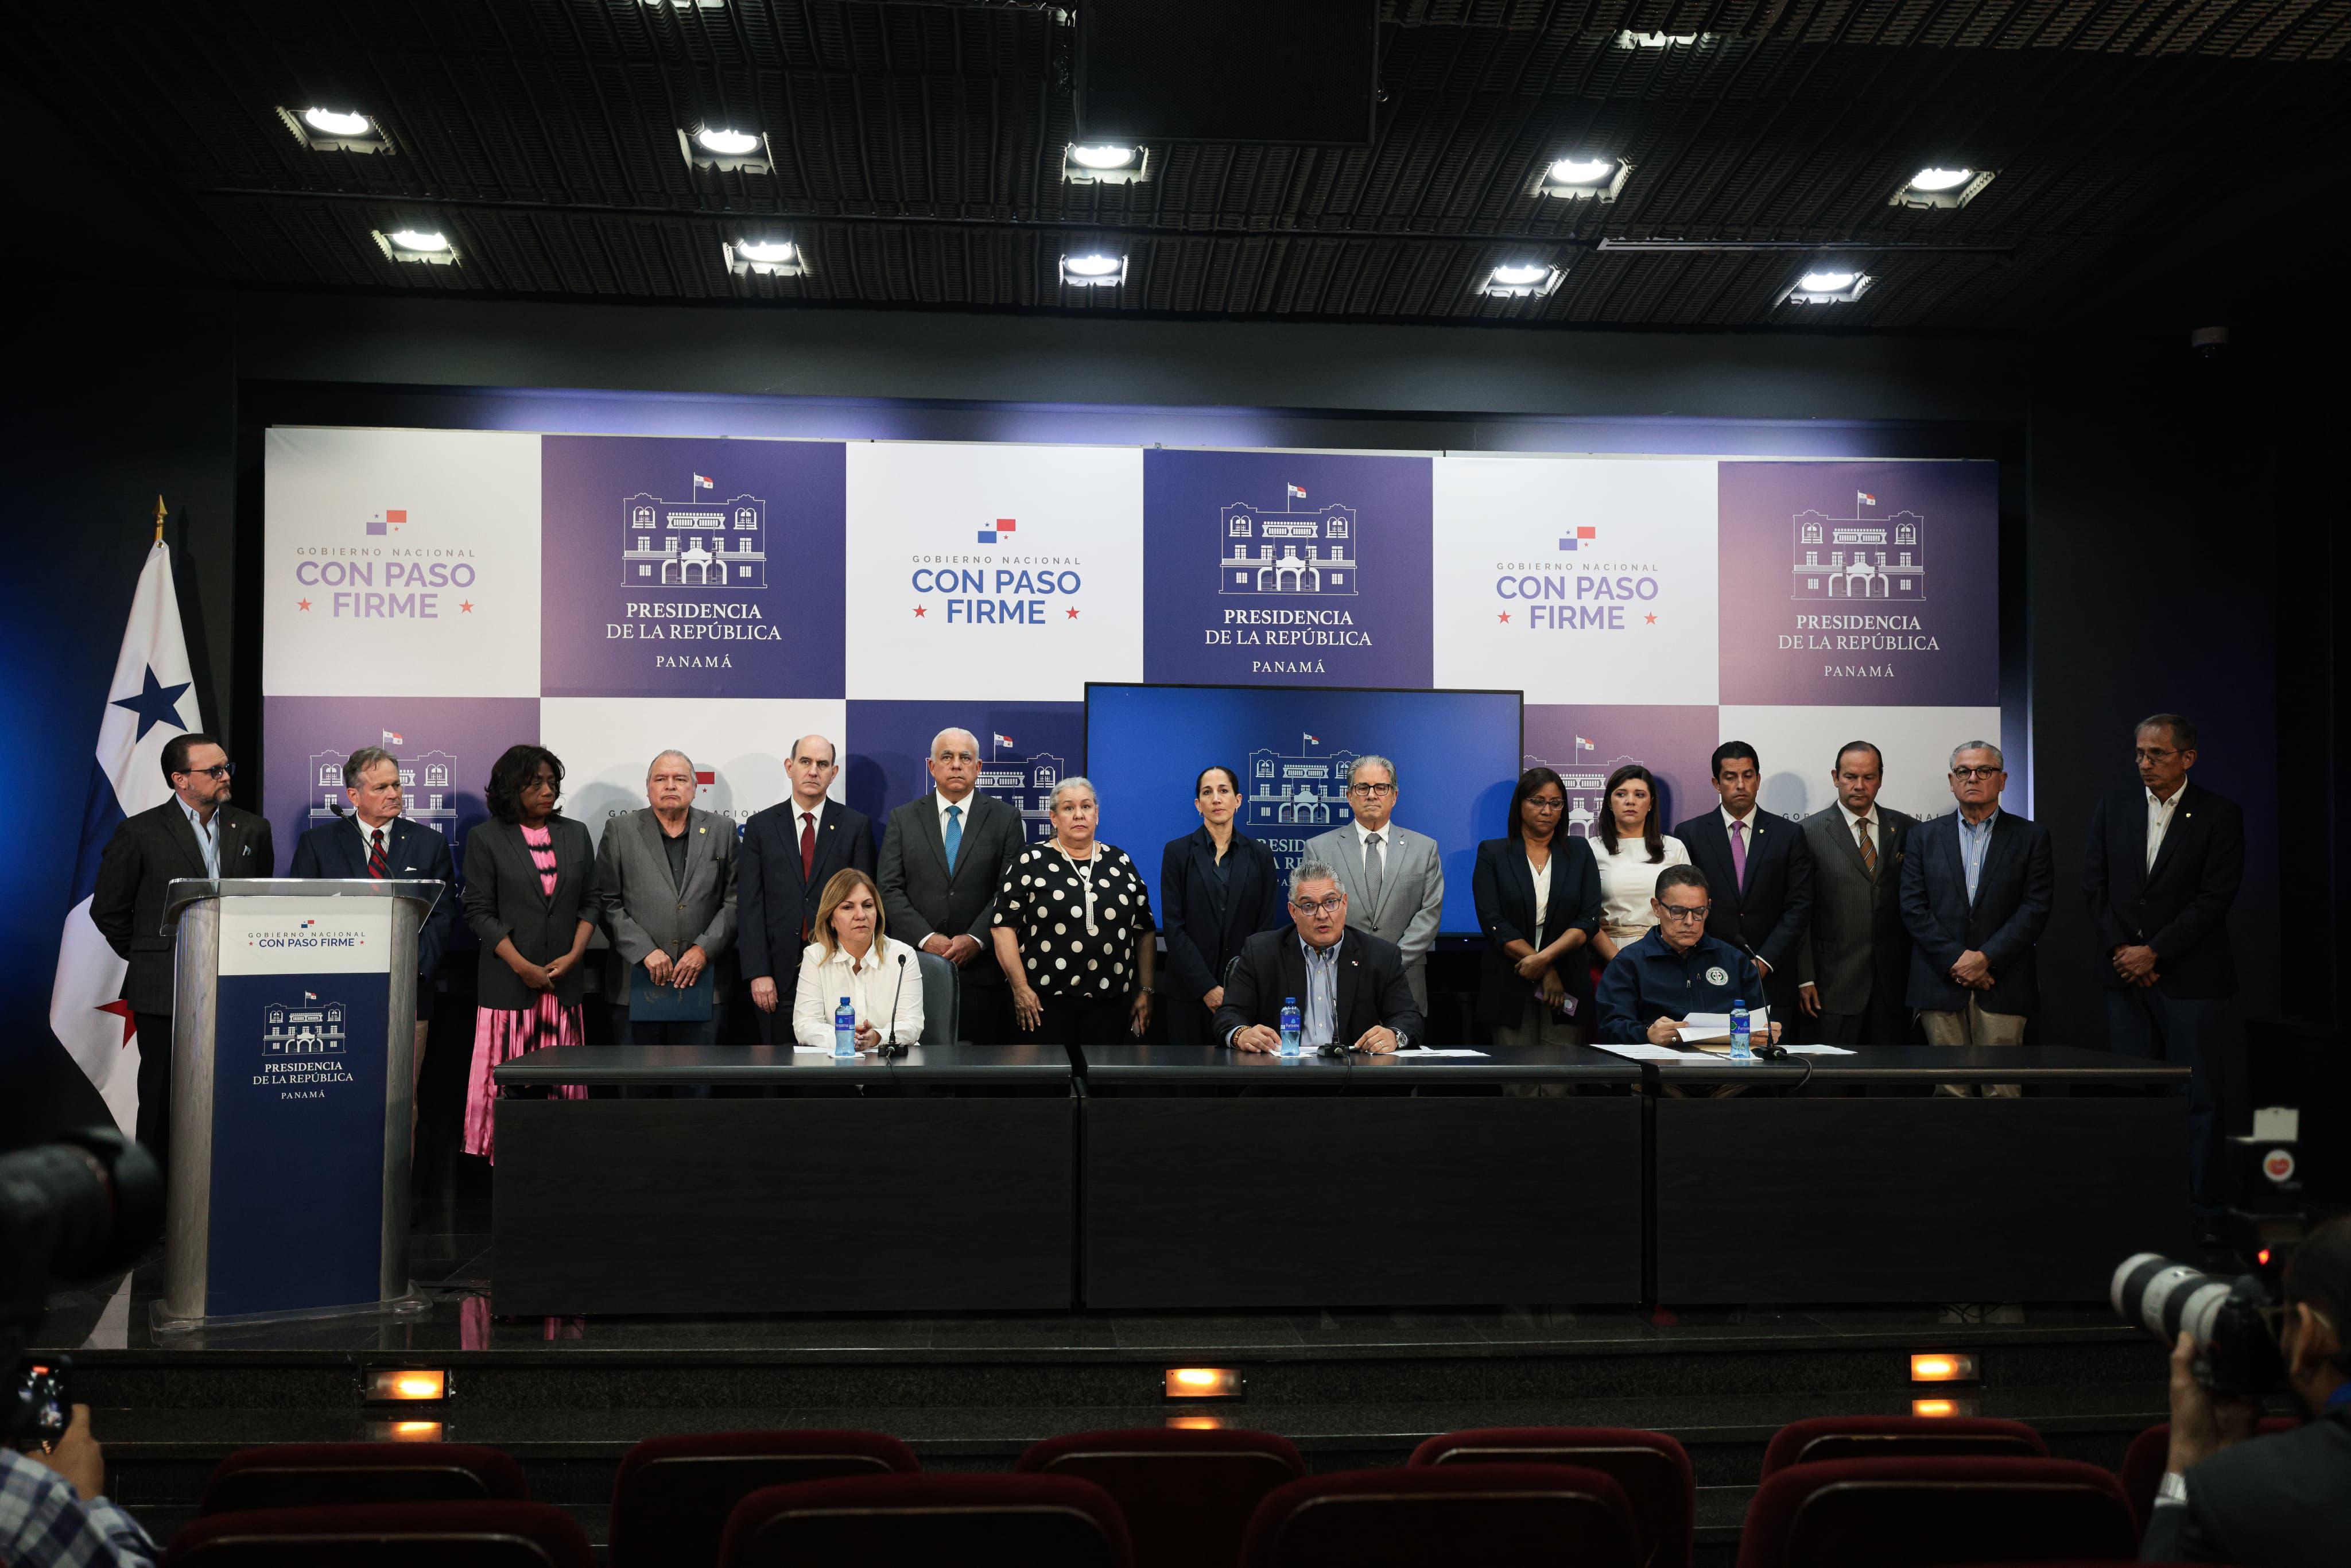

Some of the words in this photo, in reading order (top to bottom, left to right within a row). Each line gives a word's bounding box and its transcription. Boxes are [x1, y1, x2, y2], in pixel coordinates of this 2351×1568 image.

[297, 548, 381, 556] GOBIERNO
[393, 549, 475, 557] NACIONAL
[296, 561, 372, 586] CON
[386, 562, 475, 587] PASO
[912, 569, 983, 593] CON
[996, 570, 1080, 594] PASO
[1497, 576, 1565, 599] CON
[1577, 576, 1658, 600] PASO
[333, 592, 437, 618] FIRME
[626, 603, 762, 618] PRESIDENCIA
[948, 599, 1045, 624] FIRME
[1224, 610, 1353, 624] PRESIDENCIA
[1531, 606, 1624, 629] FIRME
[1796, 615, 1921, 630] PRESIDENCIA
[606, 624, 634, 638] DE
[639, 624, 665, 638] LA
[670, 622, 782, 639] REPÚBLICA
[1205, 630, 1231, 644] DE
[1237, 631, 1260, 644] LA
[1266, 627, 1372, 645] REPÚBLICA
[1779, 635, 1803, 649] DE
[1809, 635, 1832, 649] LA
[1837, 632, 1939, 650] REPÚBLICA
[657, 654, 732, 667] PANAMÁ
[1253, 659, 1325, 672] PANAMÁ
[1825, 664, 1894, 677] PANAMÁ
[259, 939, 284, 947] CON
[288, 939, 317, 947] PASO
[321, 938, 354, 946] FIRME
[265, 1062, 343, 1072] PRESIDENCIA
[253, 1076, 269, 1084] DE
[272, 1076, 286, 1084] LA
[290, 1072, 353, 1083] REPÚBLICA
[282, 1090, 324, 1099] PANAMÁ
